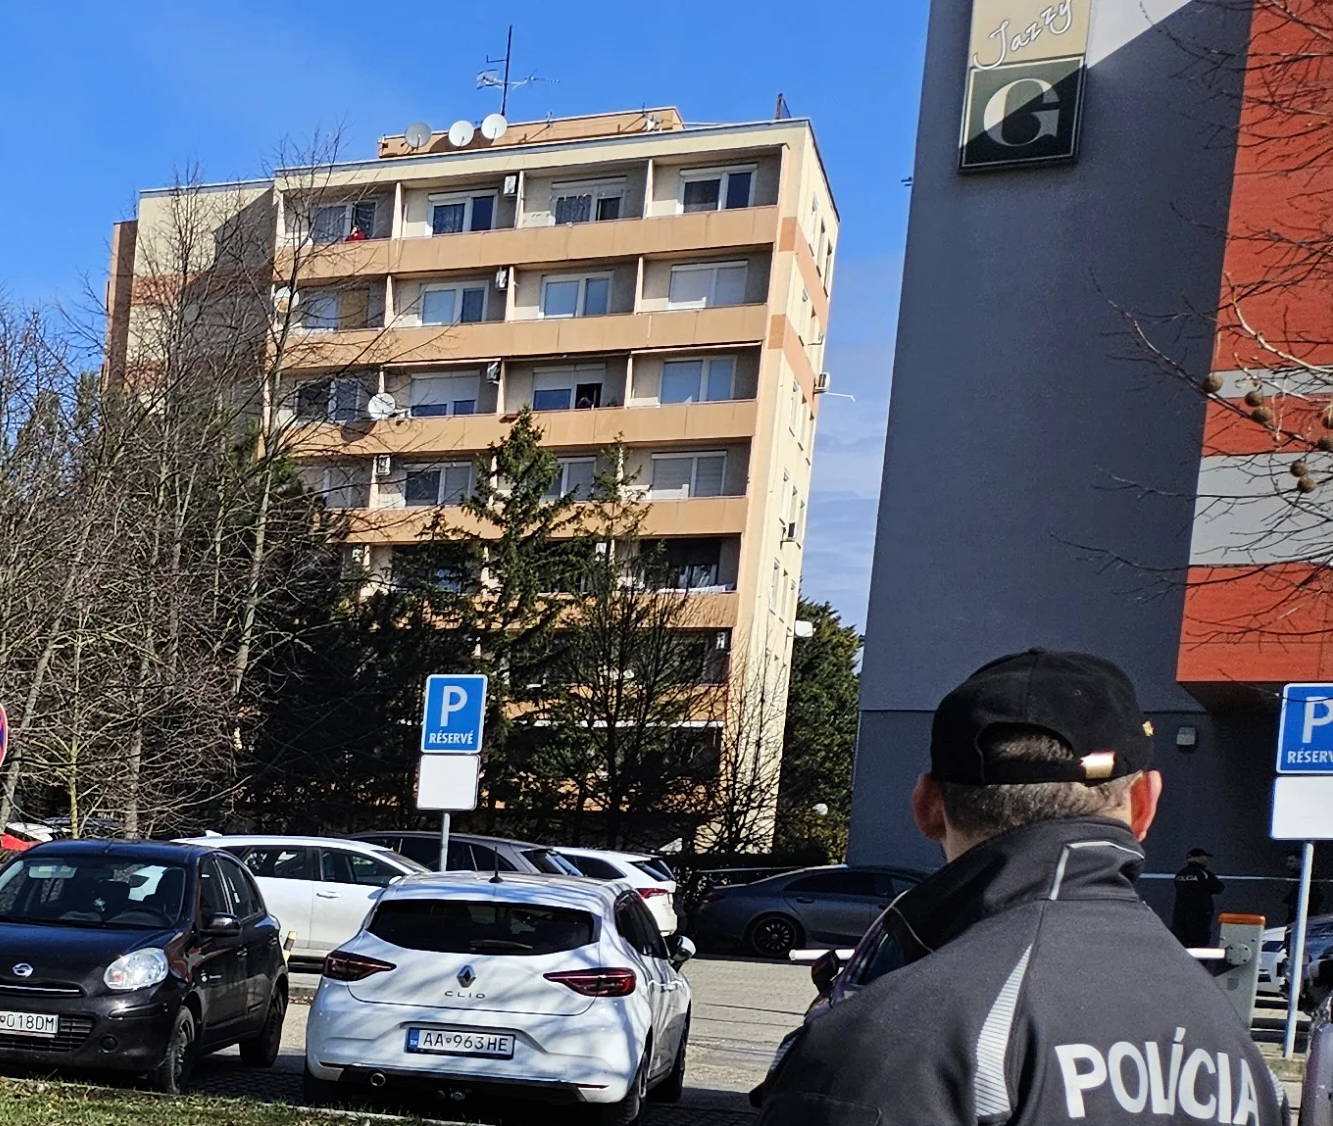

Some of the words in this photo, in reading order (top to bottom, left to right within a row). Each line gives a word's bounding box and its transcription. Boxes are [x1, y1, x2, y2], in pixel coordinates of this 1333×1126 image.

[972, 0, 1073, 71] Jazzy
[983, 77, 1061, 147] G
[440, 685, 468, 727] P
[1302, 696, 1333, 744] P
[428, 729, 474, 744] RÉSERVÉ
[444, 990, 486, 999] CLIO
[423, 1032, 444, 1047] AA
